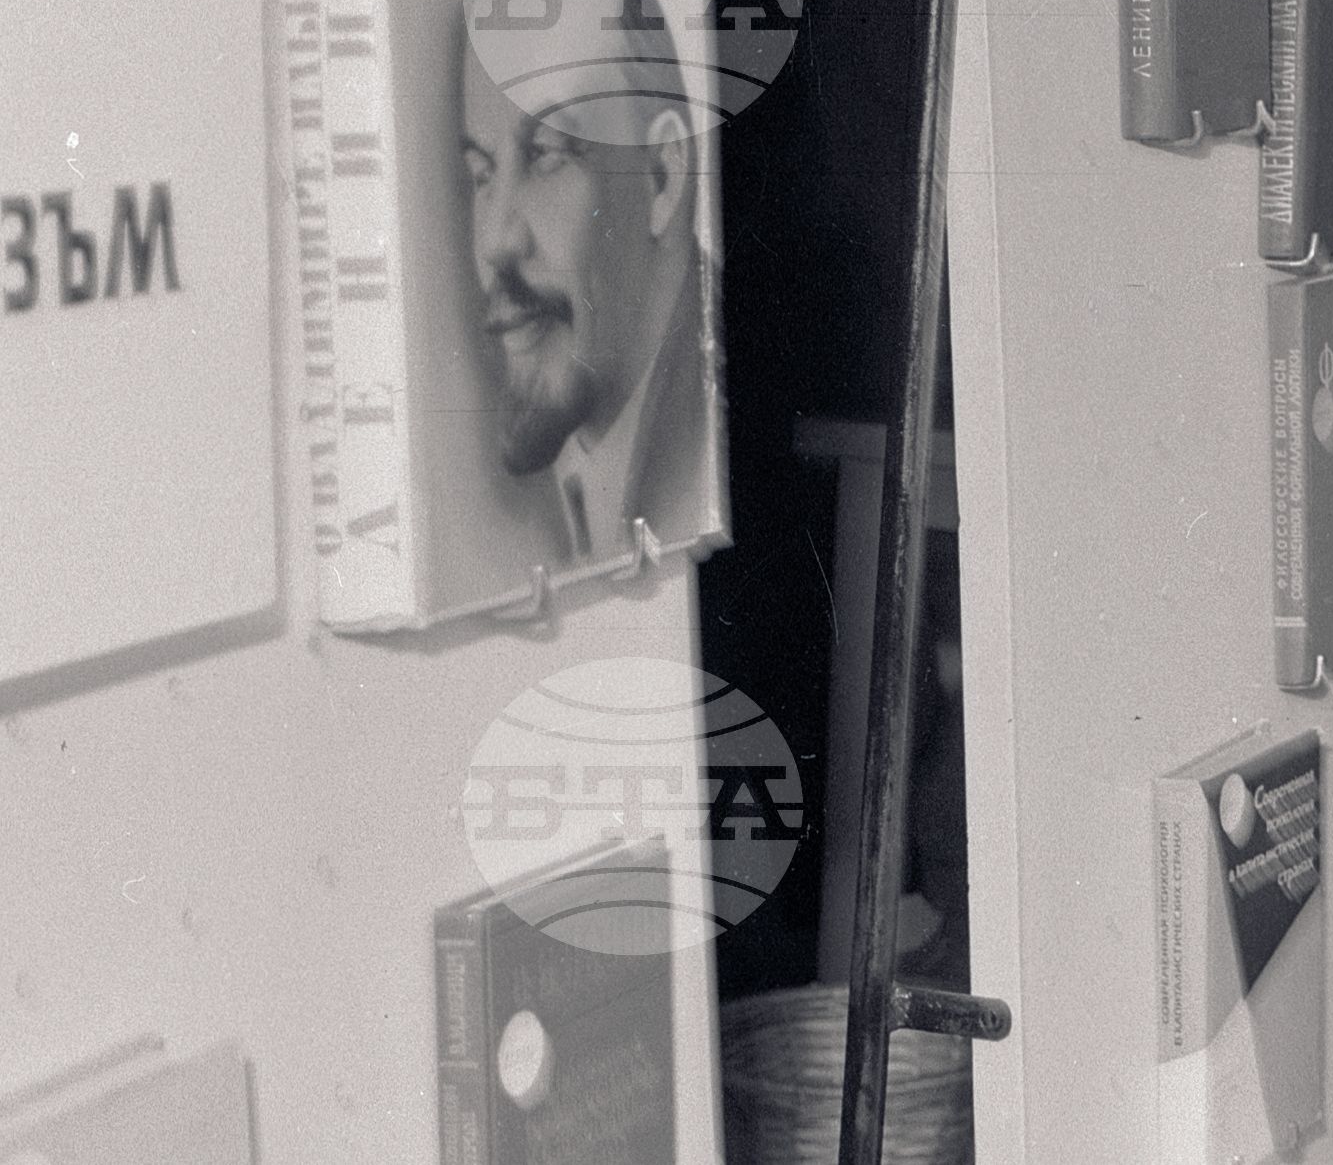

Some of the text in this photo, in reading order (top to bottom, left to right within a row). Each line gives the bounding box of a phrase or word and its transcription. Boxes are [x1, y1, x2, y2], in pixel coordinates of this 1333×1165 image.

[0, 179, 181, 315] ЗЪМ
[1288, 348, 1301, 407] ЛОГИКИ
[313, 523, 343, 558] О
[1273, 358, 1289, 590] ФИЛОСОФСКИЕ ВОПРОСЫ
[1172, 821, 1182, 882] СТРАНАХ
[1158, 821, 1170, 1026] СОВРЕМЕННАЯ ПСИХОЛОГИЯ
[1172, 887, 1183, 1034] КАПИТАЛИСТИЧЕСКИХ
